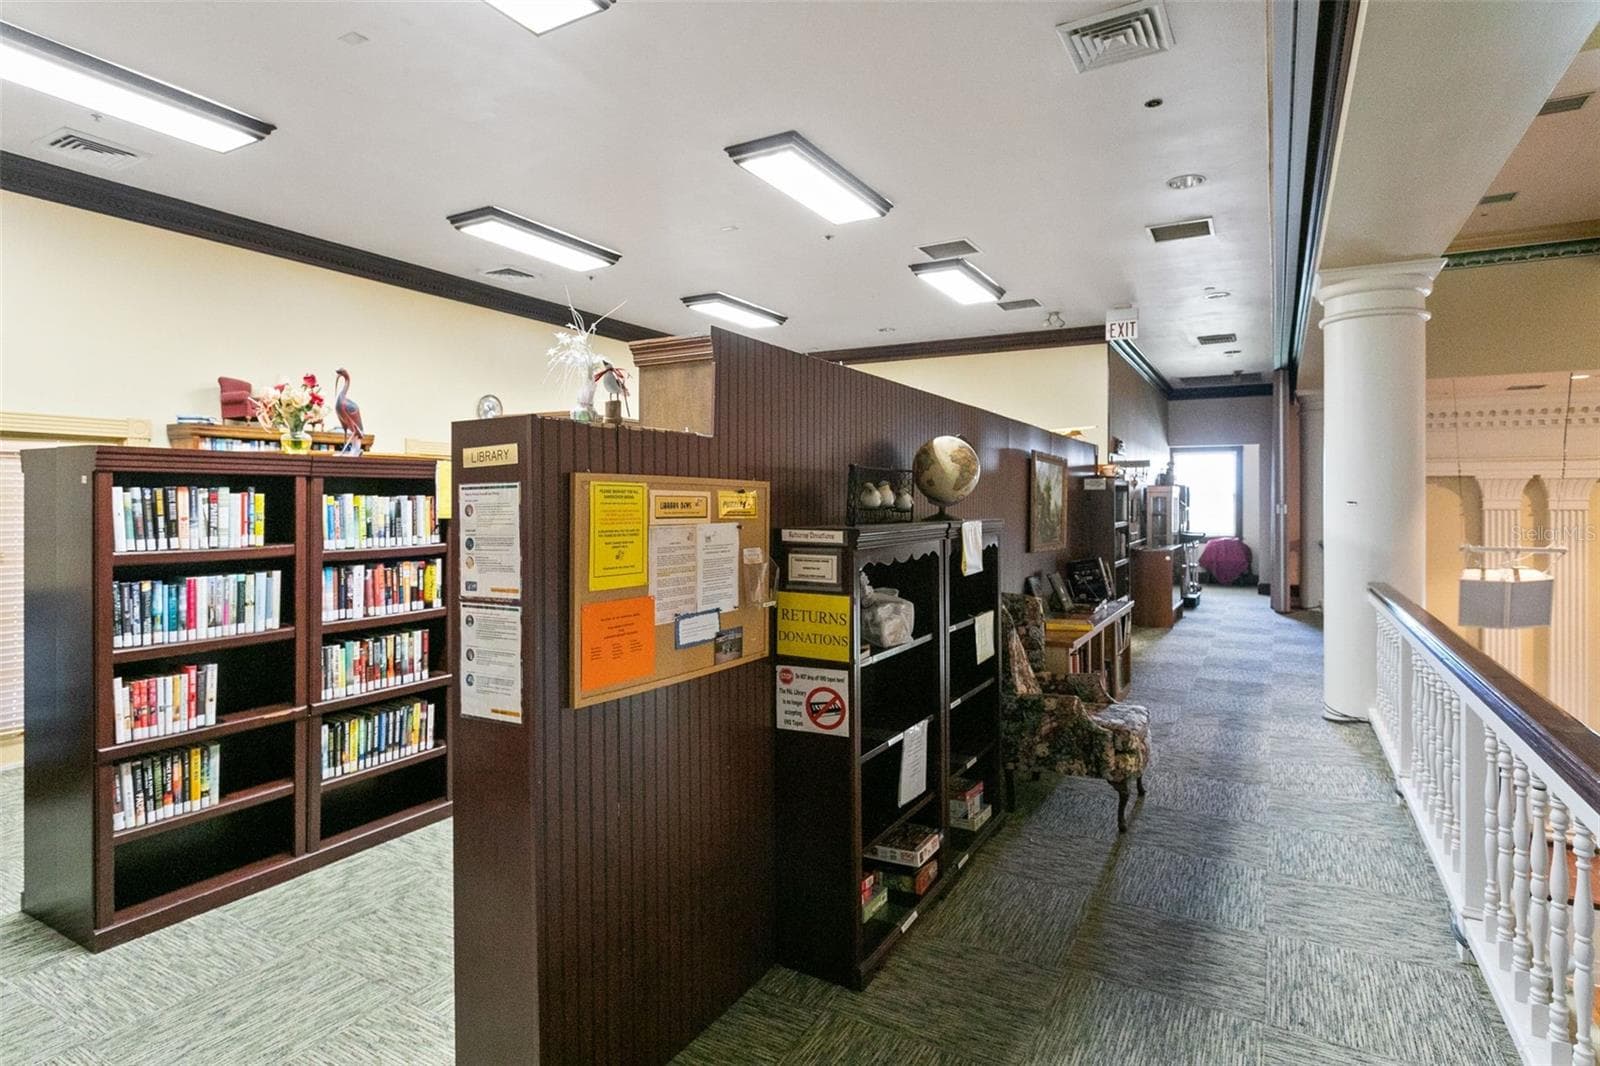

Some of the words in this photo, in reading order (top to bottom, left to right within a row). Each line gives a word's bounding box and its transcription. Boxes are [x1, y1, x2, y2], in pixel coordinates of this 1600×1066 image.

[1110, 321, 1136, 338] EXIT
[471, 449, 510, 463] LIBRARY
[781, 608, 847, 626] RETURNS
[778, 631, 848, 648] DONATIONS
